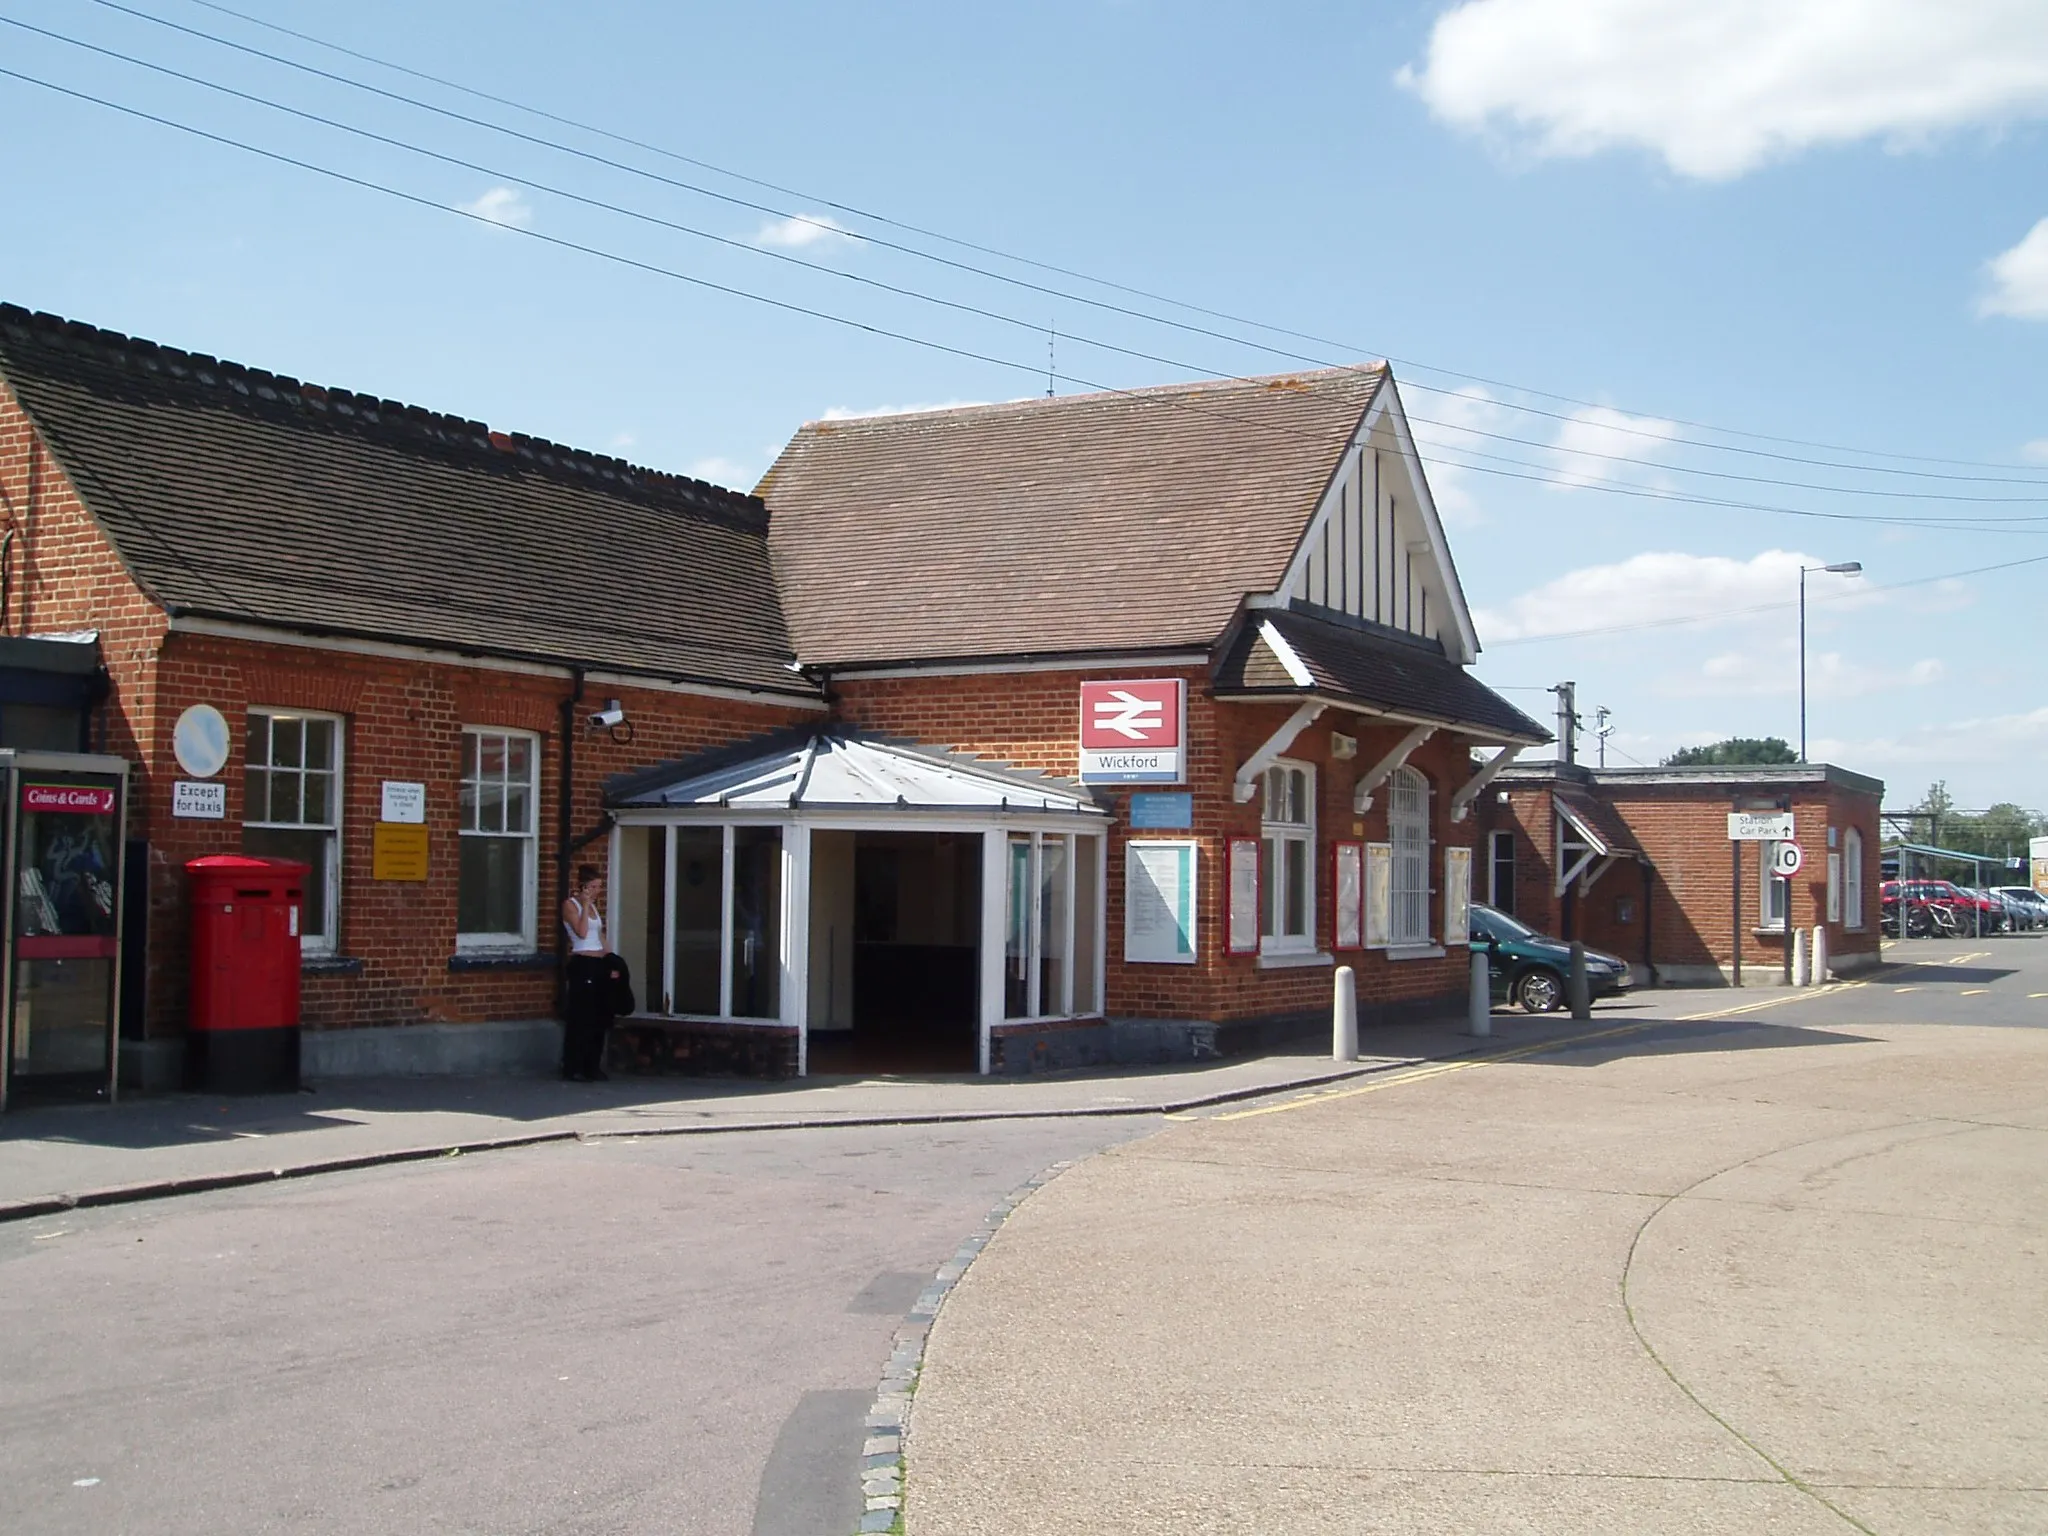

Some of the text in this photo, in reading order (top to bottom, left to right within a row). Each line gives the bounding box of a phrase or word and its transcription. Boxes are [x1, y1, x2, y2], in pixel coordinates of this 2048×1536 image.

[1099, 755, 1158, 768] Wickford
[28, 789, 98, 805] Coins & Cards
[180, 784, 218, 798] Except
[176, 799, 221, 812] for taxis
[1740, 816, 1773, 825] Station
[1740, 826, 1778, 835] Car Park
